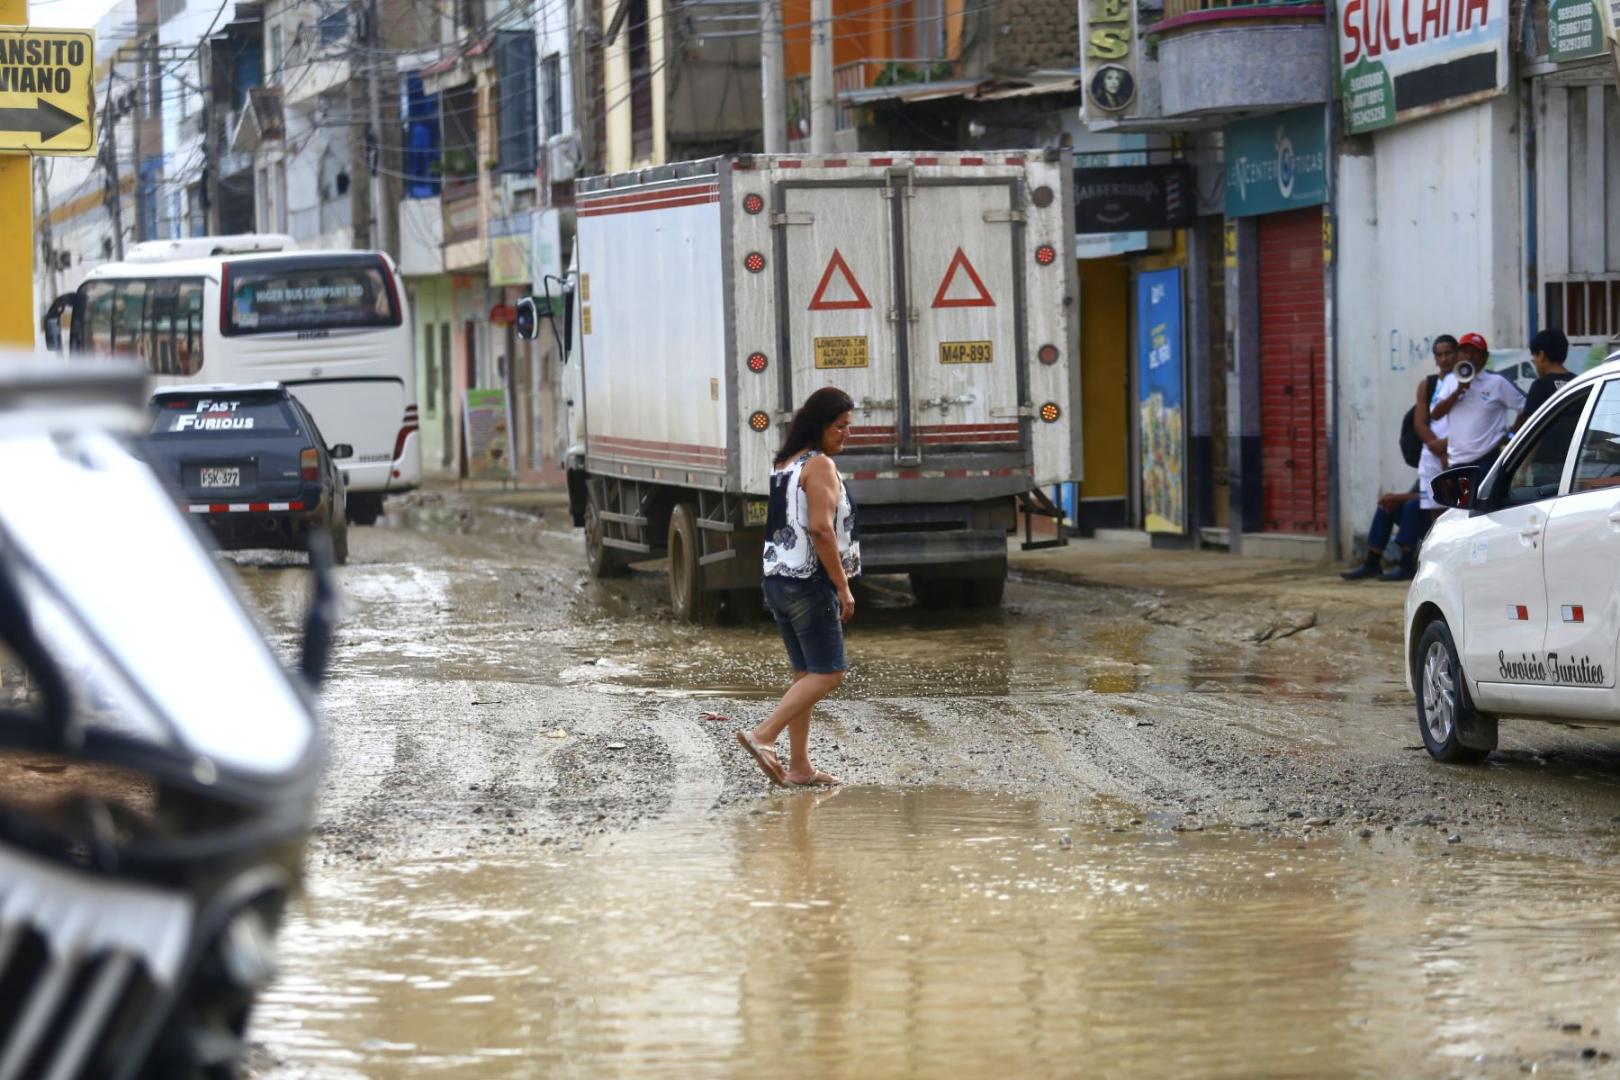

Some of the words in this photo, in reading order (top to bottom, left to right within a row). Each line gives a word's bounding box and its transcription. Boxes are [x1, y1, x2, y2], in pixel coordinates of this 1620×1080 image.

[285, 287, 303, 300] BUS
[942, 345, 991, 362] M4P-893
[1498, 650, 1548, 682] Servicio
